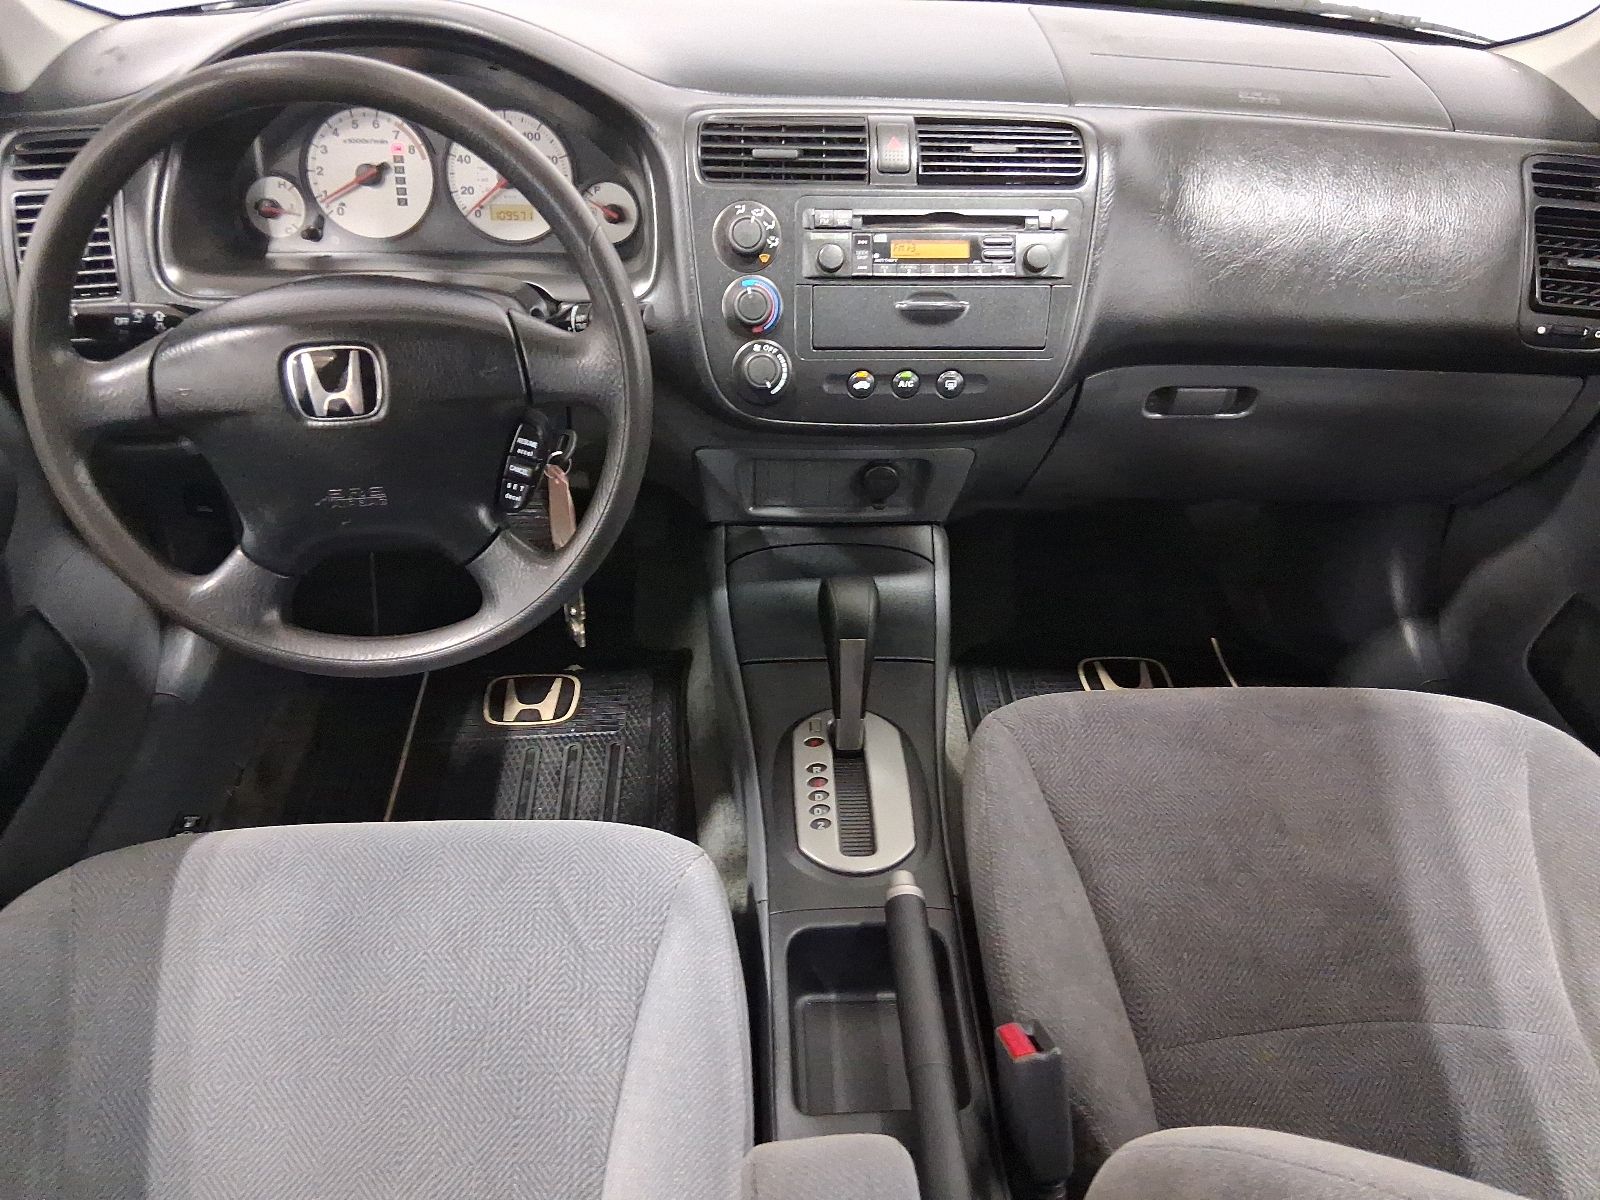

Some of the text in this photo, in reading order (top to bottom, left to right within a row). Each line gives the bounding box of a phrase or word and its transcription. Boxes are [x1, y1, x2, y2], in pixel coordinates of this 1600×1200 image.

[351, 119, 359, 129] 5
[372, 119, 380, 129] 6
[331, 127, 339, 137] 4
[391, 130, 400, 139] 7
[319, 145, 328, 154] 3
[407, 145, 415, 154] 8
[456, 154, 472, 164] 40
[316, 166, 324, 176] 2
[460, 185, 475, 195] 20
[336, 206, 345, 216] 0
[474, 209, 482, 218] 0
[762, 343, 779, 355] OFF
[897, 379, 915, 388] A/C
[817, 821, 826, 830] 2
